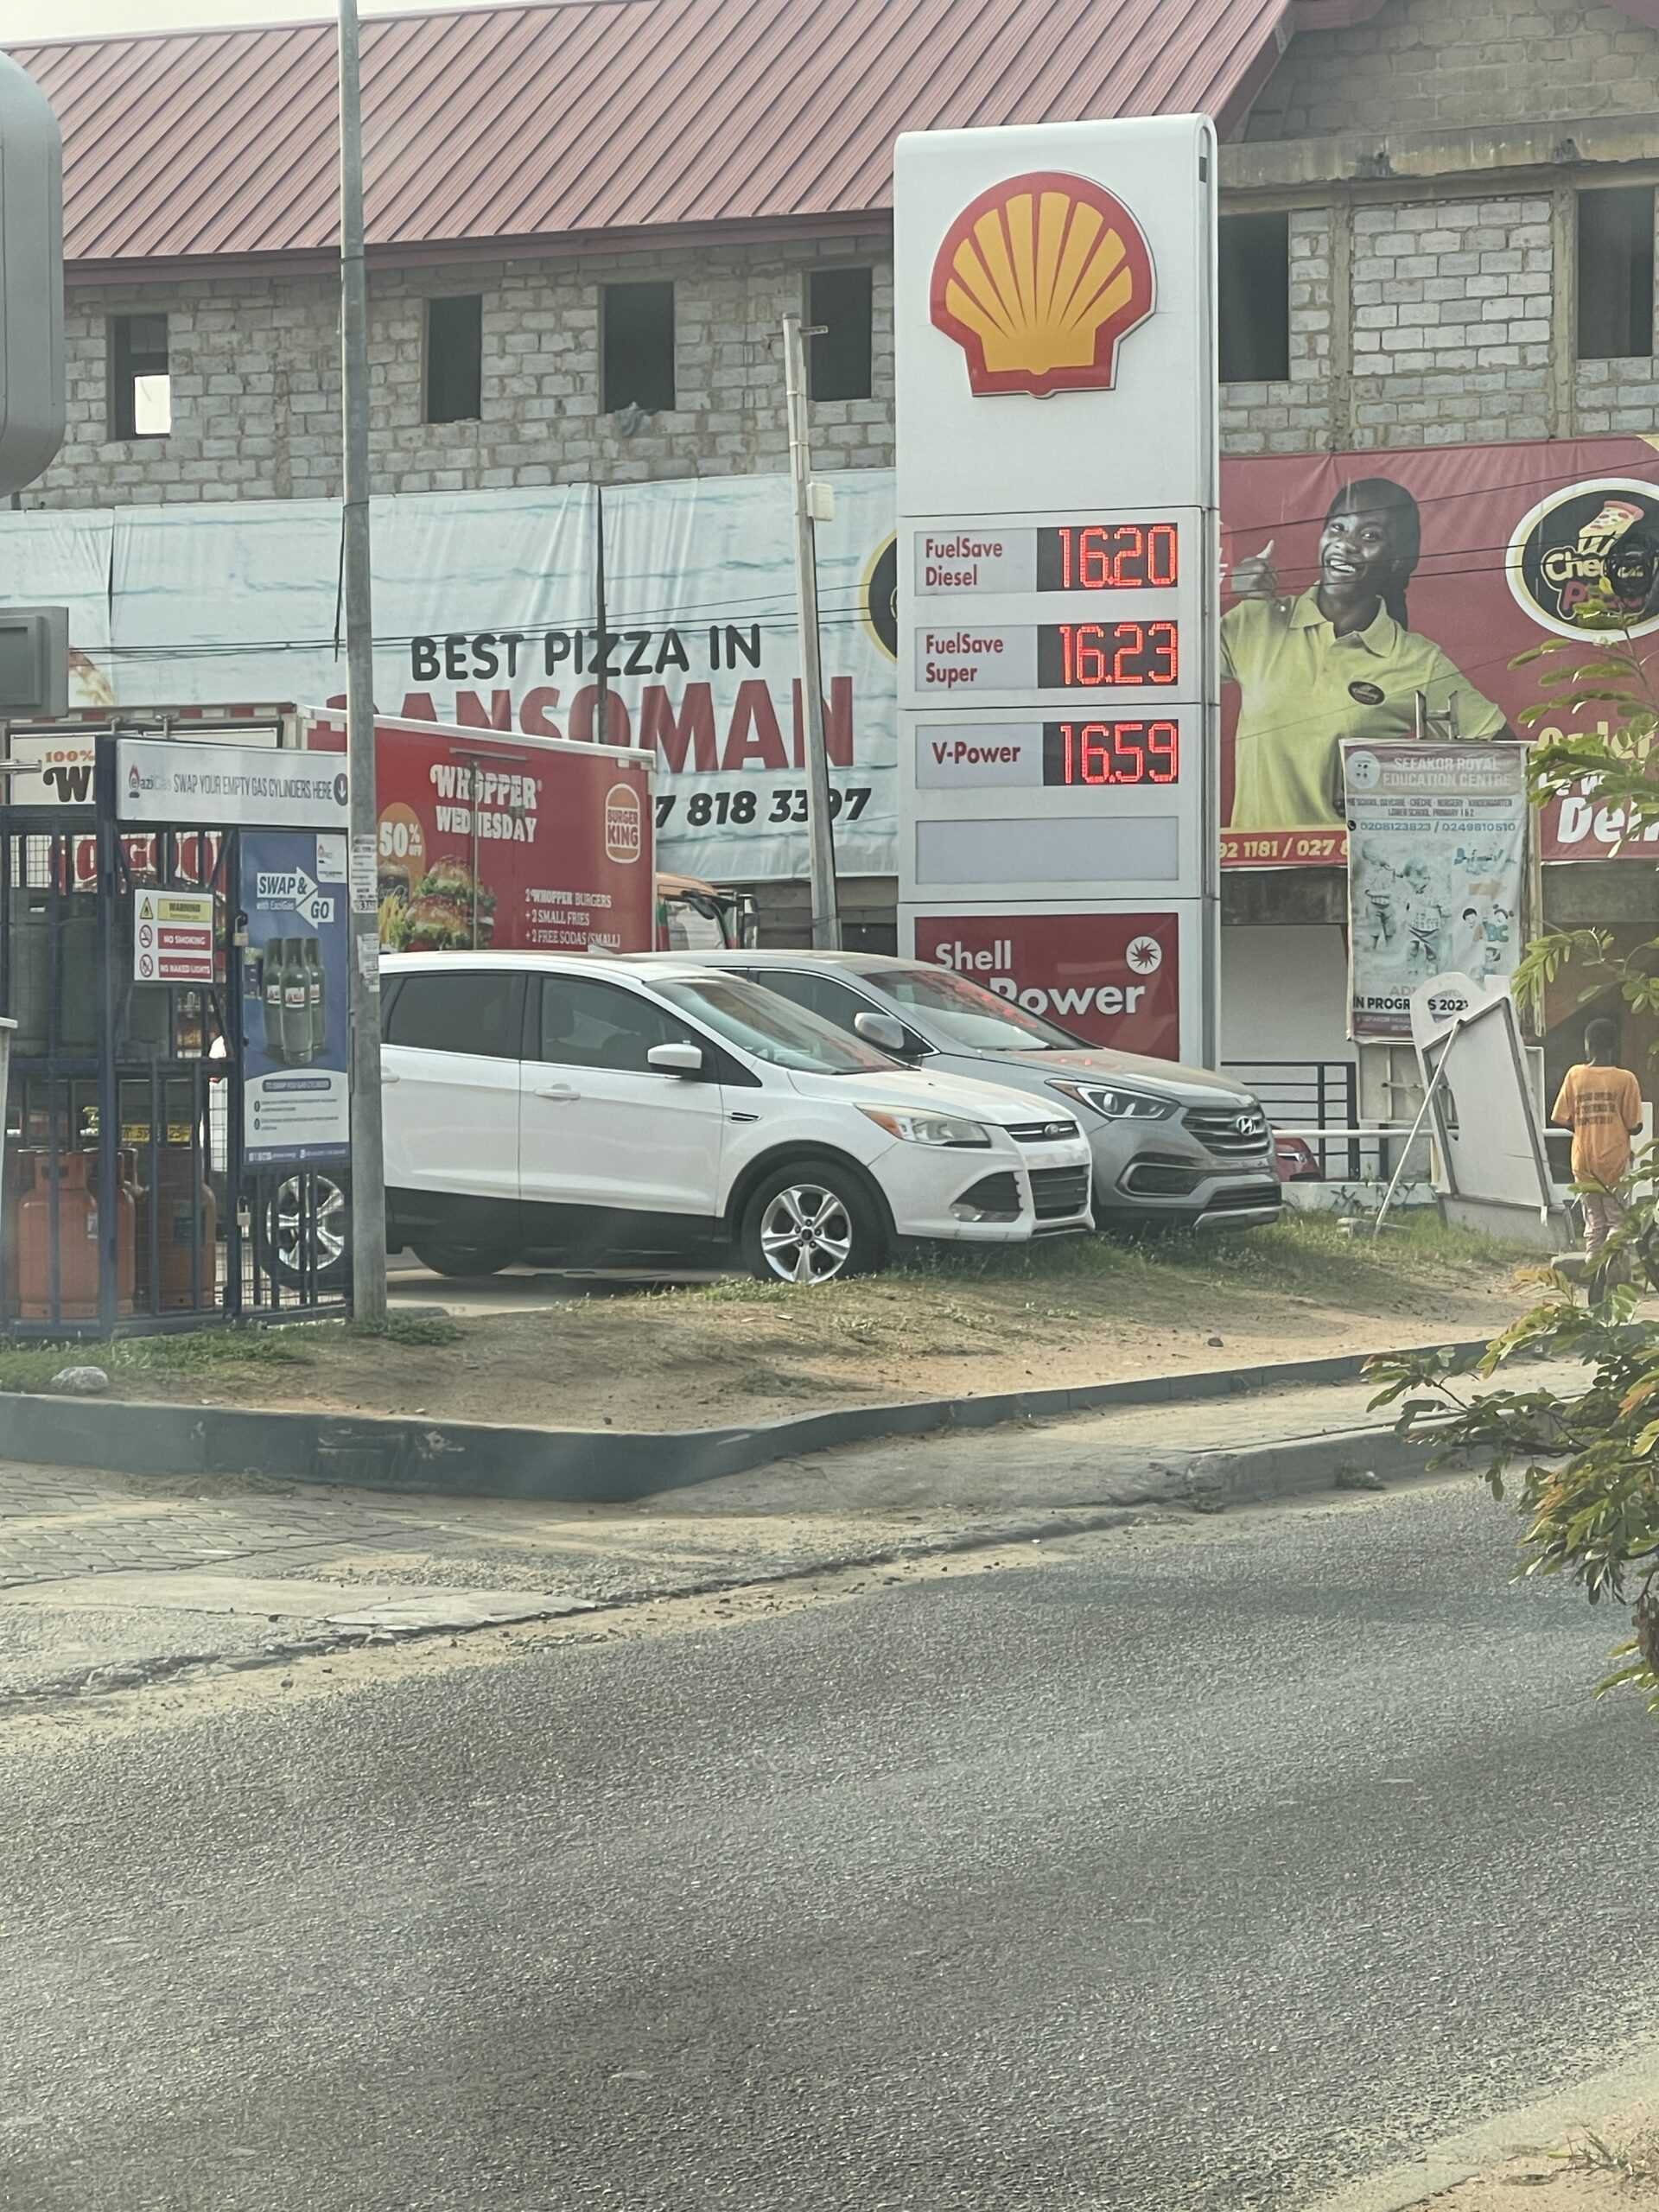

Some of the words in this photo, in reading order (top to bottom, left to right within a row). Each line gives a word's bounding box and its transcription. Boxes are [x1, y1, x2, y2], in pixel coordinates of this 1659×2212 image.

[925, 536, 1003, 558] FuelSave
[925, 564, 977, 587] Diesel
[410, 633, 524, 681] BEST
[544, 628, 690, 677] PIZZA
[709, 624, 760, 671] IN
[925, 632, 1003, 655] FuelSave
[1059, 623, 1178, 685] 16.23
[925, 663, 978, 688] Super
[931, 742, 1020, 765] V-Power
[1456, 757, 1500, 771] ROYAL
[174, 774, 197, 793] SWAP
[199, 775, 221, 794] YOUR
[222, 776, 251, 795] EMPTY
[251, 778, 267, 797] GAS
[269, 779, 311, 798] CYLINDERS
[312, 780, 332, 799] HERE
[1383, 772, 1456, 787] EDUCATION
[1459, 772, 1511, 787] CENTRE
[607, 809, 639, 824] BURGER
[687, 791, 757, 827] 818
[608, 824, 639, 846] KING
[1243, 841, 1278, 858] 1181
[1281, 837, 1294, 858] /
[1296, 839, 1336, 856] 027
[258, 876, 296, 895] SWAP
[296, 876, 308, 895] &
[310, 900, 329, 918] GO
[575, 893, 612, 908] BURGERS
[538, 909, 566, 924] SMALL
[568, 912, 589, 925] FRIES
[538, 929, 558, 944] FREE
[559, 930, 587, 945] SODAS
[935, 940, 1012, 970] Shell
